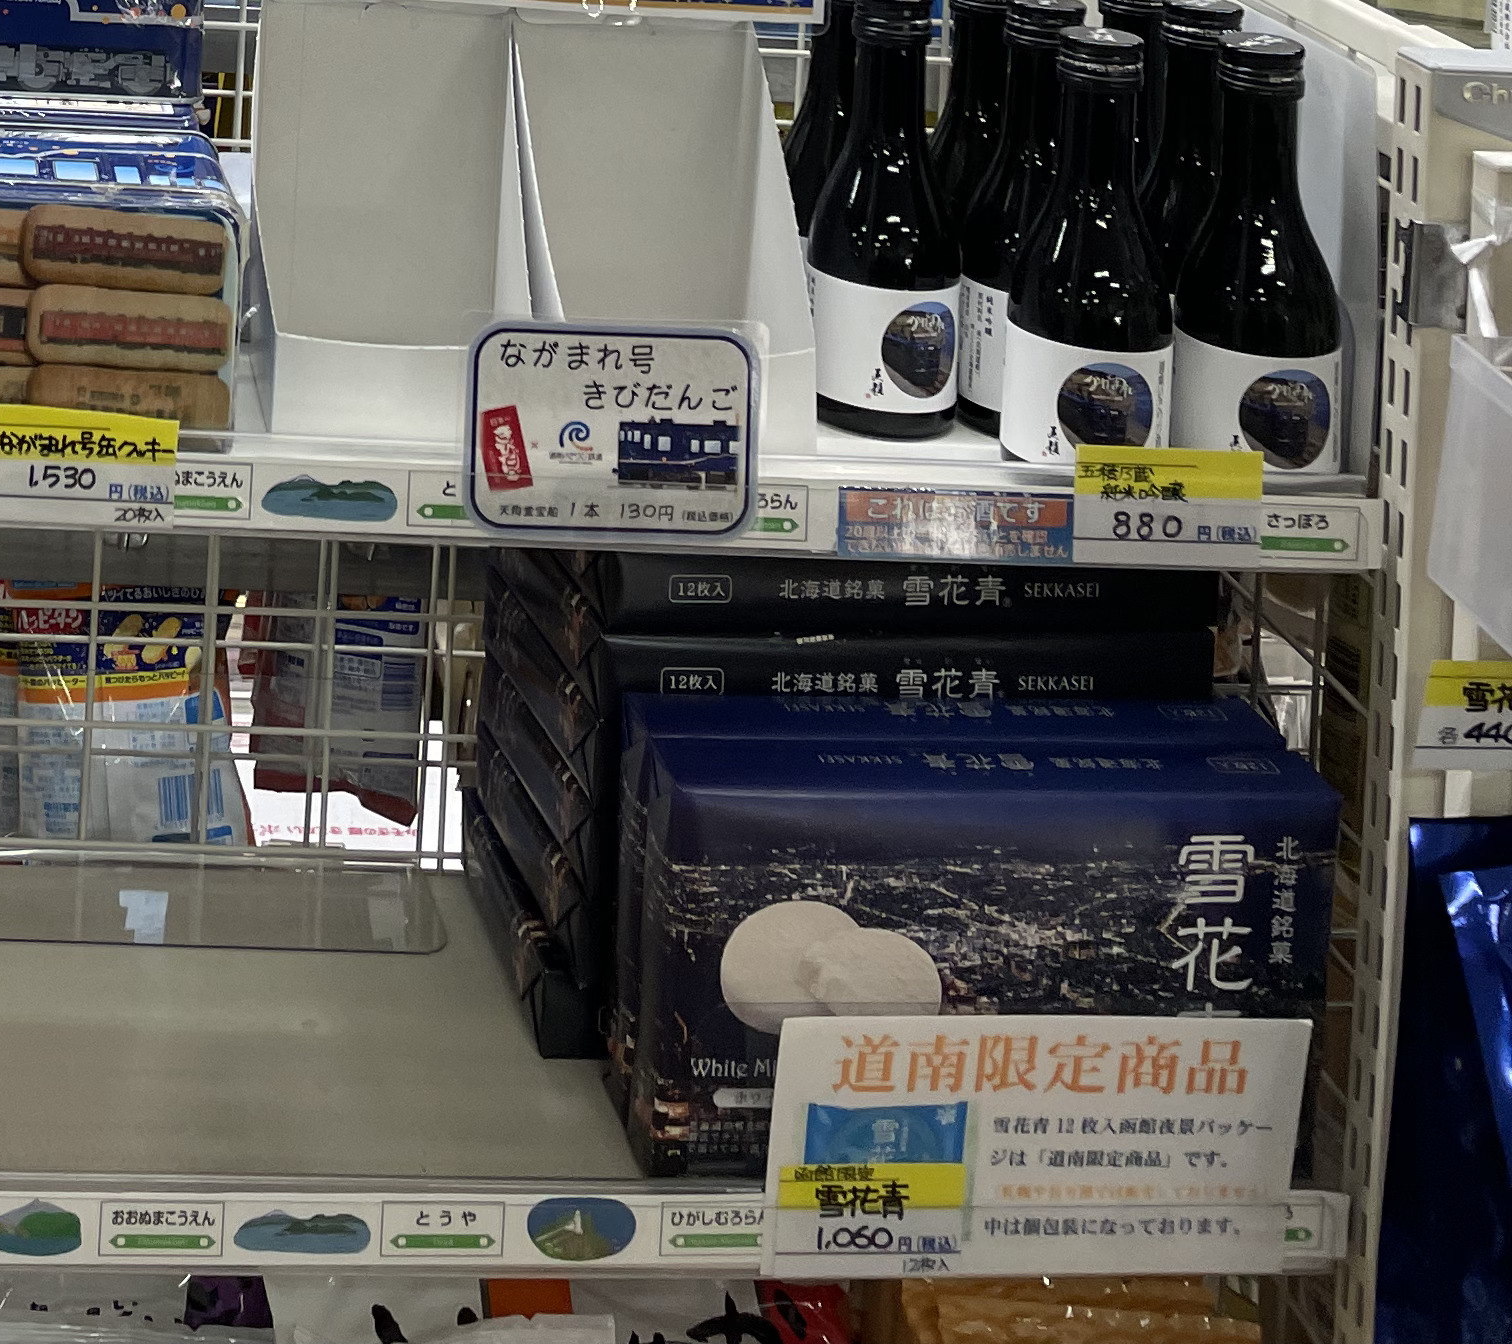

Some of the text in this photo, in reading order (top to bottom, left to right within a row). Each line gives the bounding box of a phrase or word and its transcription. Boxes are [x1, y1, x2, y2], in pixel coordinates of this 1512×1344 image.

[500, 339, 655, 374] ながまれ号
[583, 381, 739, 412] きびだんご
[114, 505, 165, 524] 20枚入
[619, 503, 674, 522] 130円
[1113, 511, 1182, 540] 880
[1267, 513, 1329, 530] さっぽろ
[676, 574, 1101, 607] 12枚入 北海道銘菓 雪花青 SEKKASEI
[668, 668, 1095, 700] 12枚入 北海道銘菓 雪花青 SEKKASEI
[1271, 837, 1299, 964] 北海道銘菓
[1172, 834, 1256, 1016] 雪花
[691, 1058, 748, 1079] White
[832, 1033, 1249, 1097] 道南限定商品
[815, 1180, 910, 1220] 雪花青
[111, 1208, 215, 1228] おおぬまこうえん
[415, 1209, 477, 1227] とうや
[984, 1217, 1241, 1238] 中は個包装になっております。
